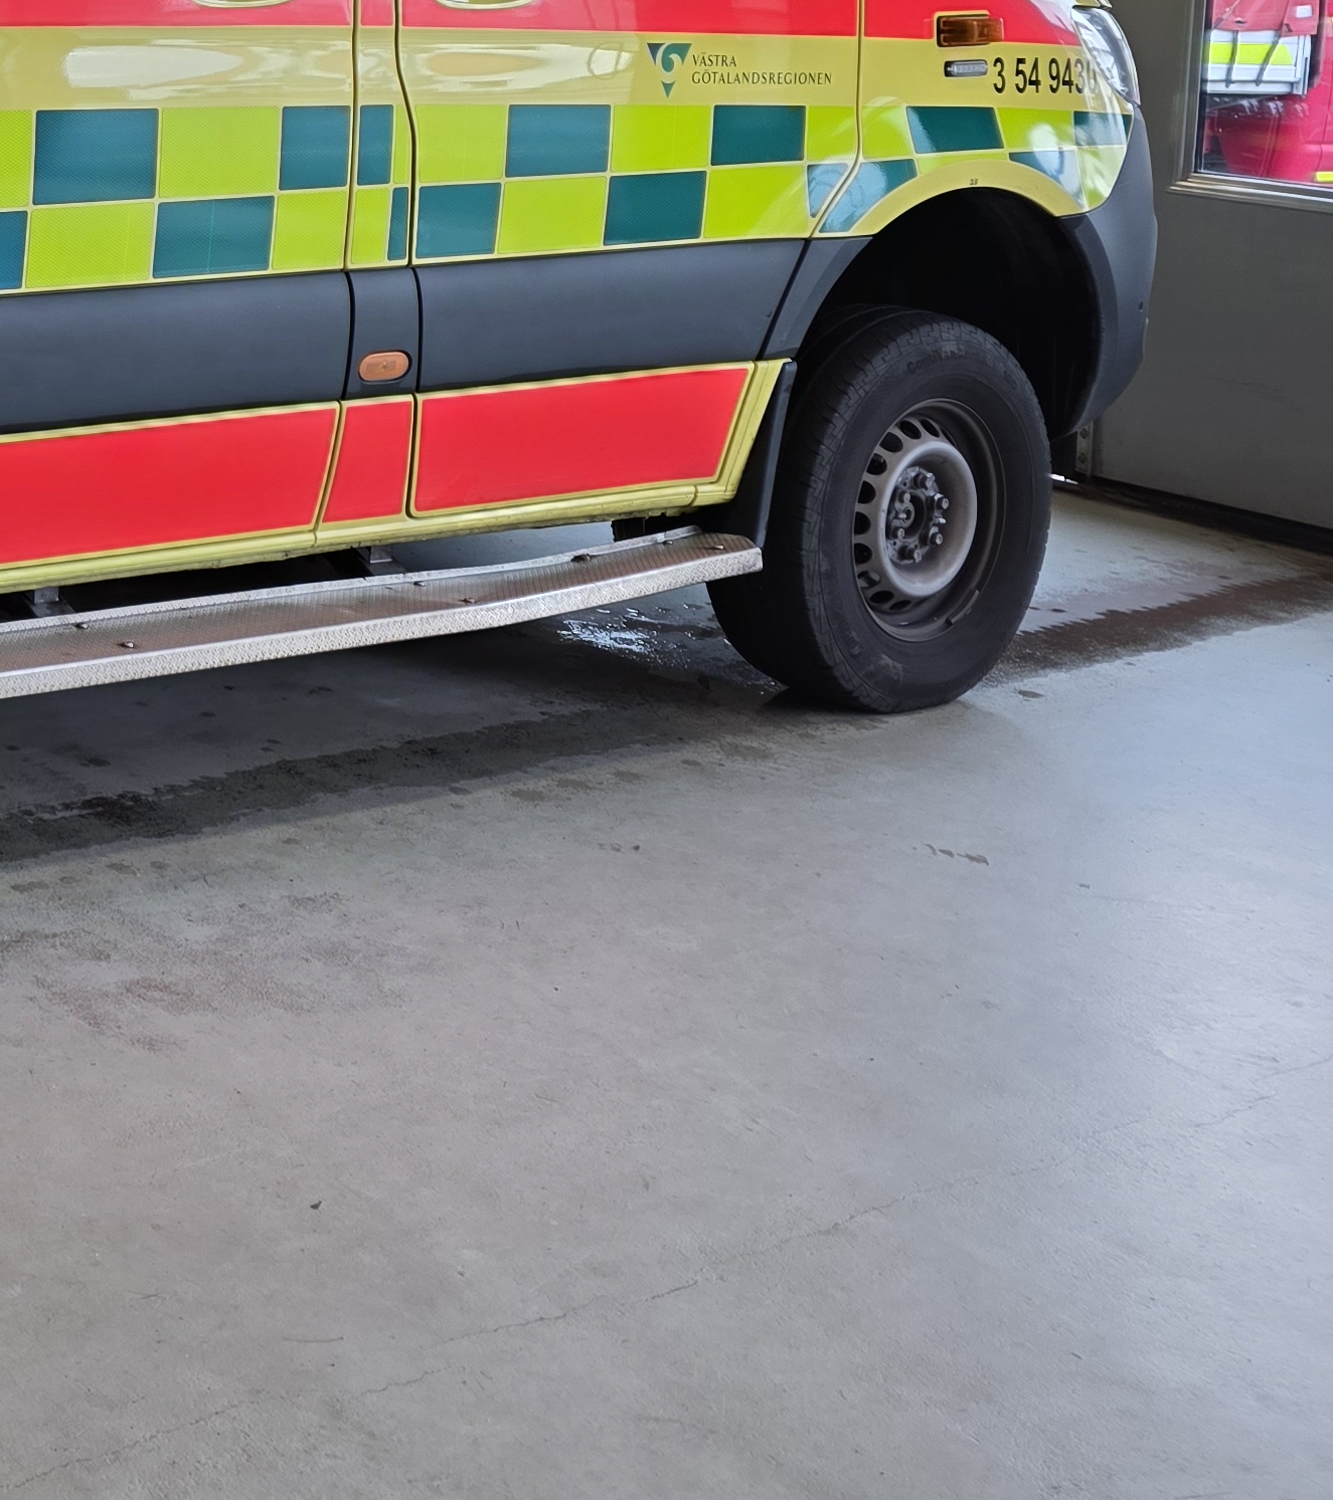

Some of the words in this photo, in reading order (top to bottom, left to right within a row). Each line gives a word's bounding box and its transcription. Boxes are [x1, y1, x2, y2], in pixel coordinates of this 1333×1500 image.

[692, 52, 738, 67] VÄSTRA
[691, 69, 833, 86] GÖTALANDSREGIONEN
[992, 56, 1007, 95] 3
[1014, 56, 1042, 95] 54
